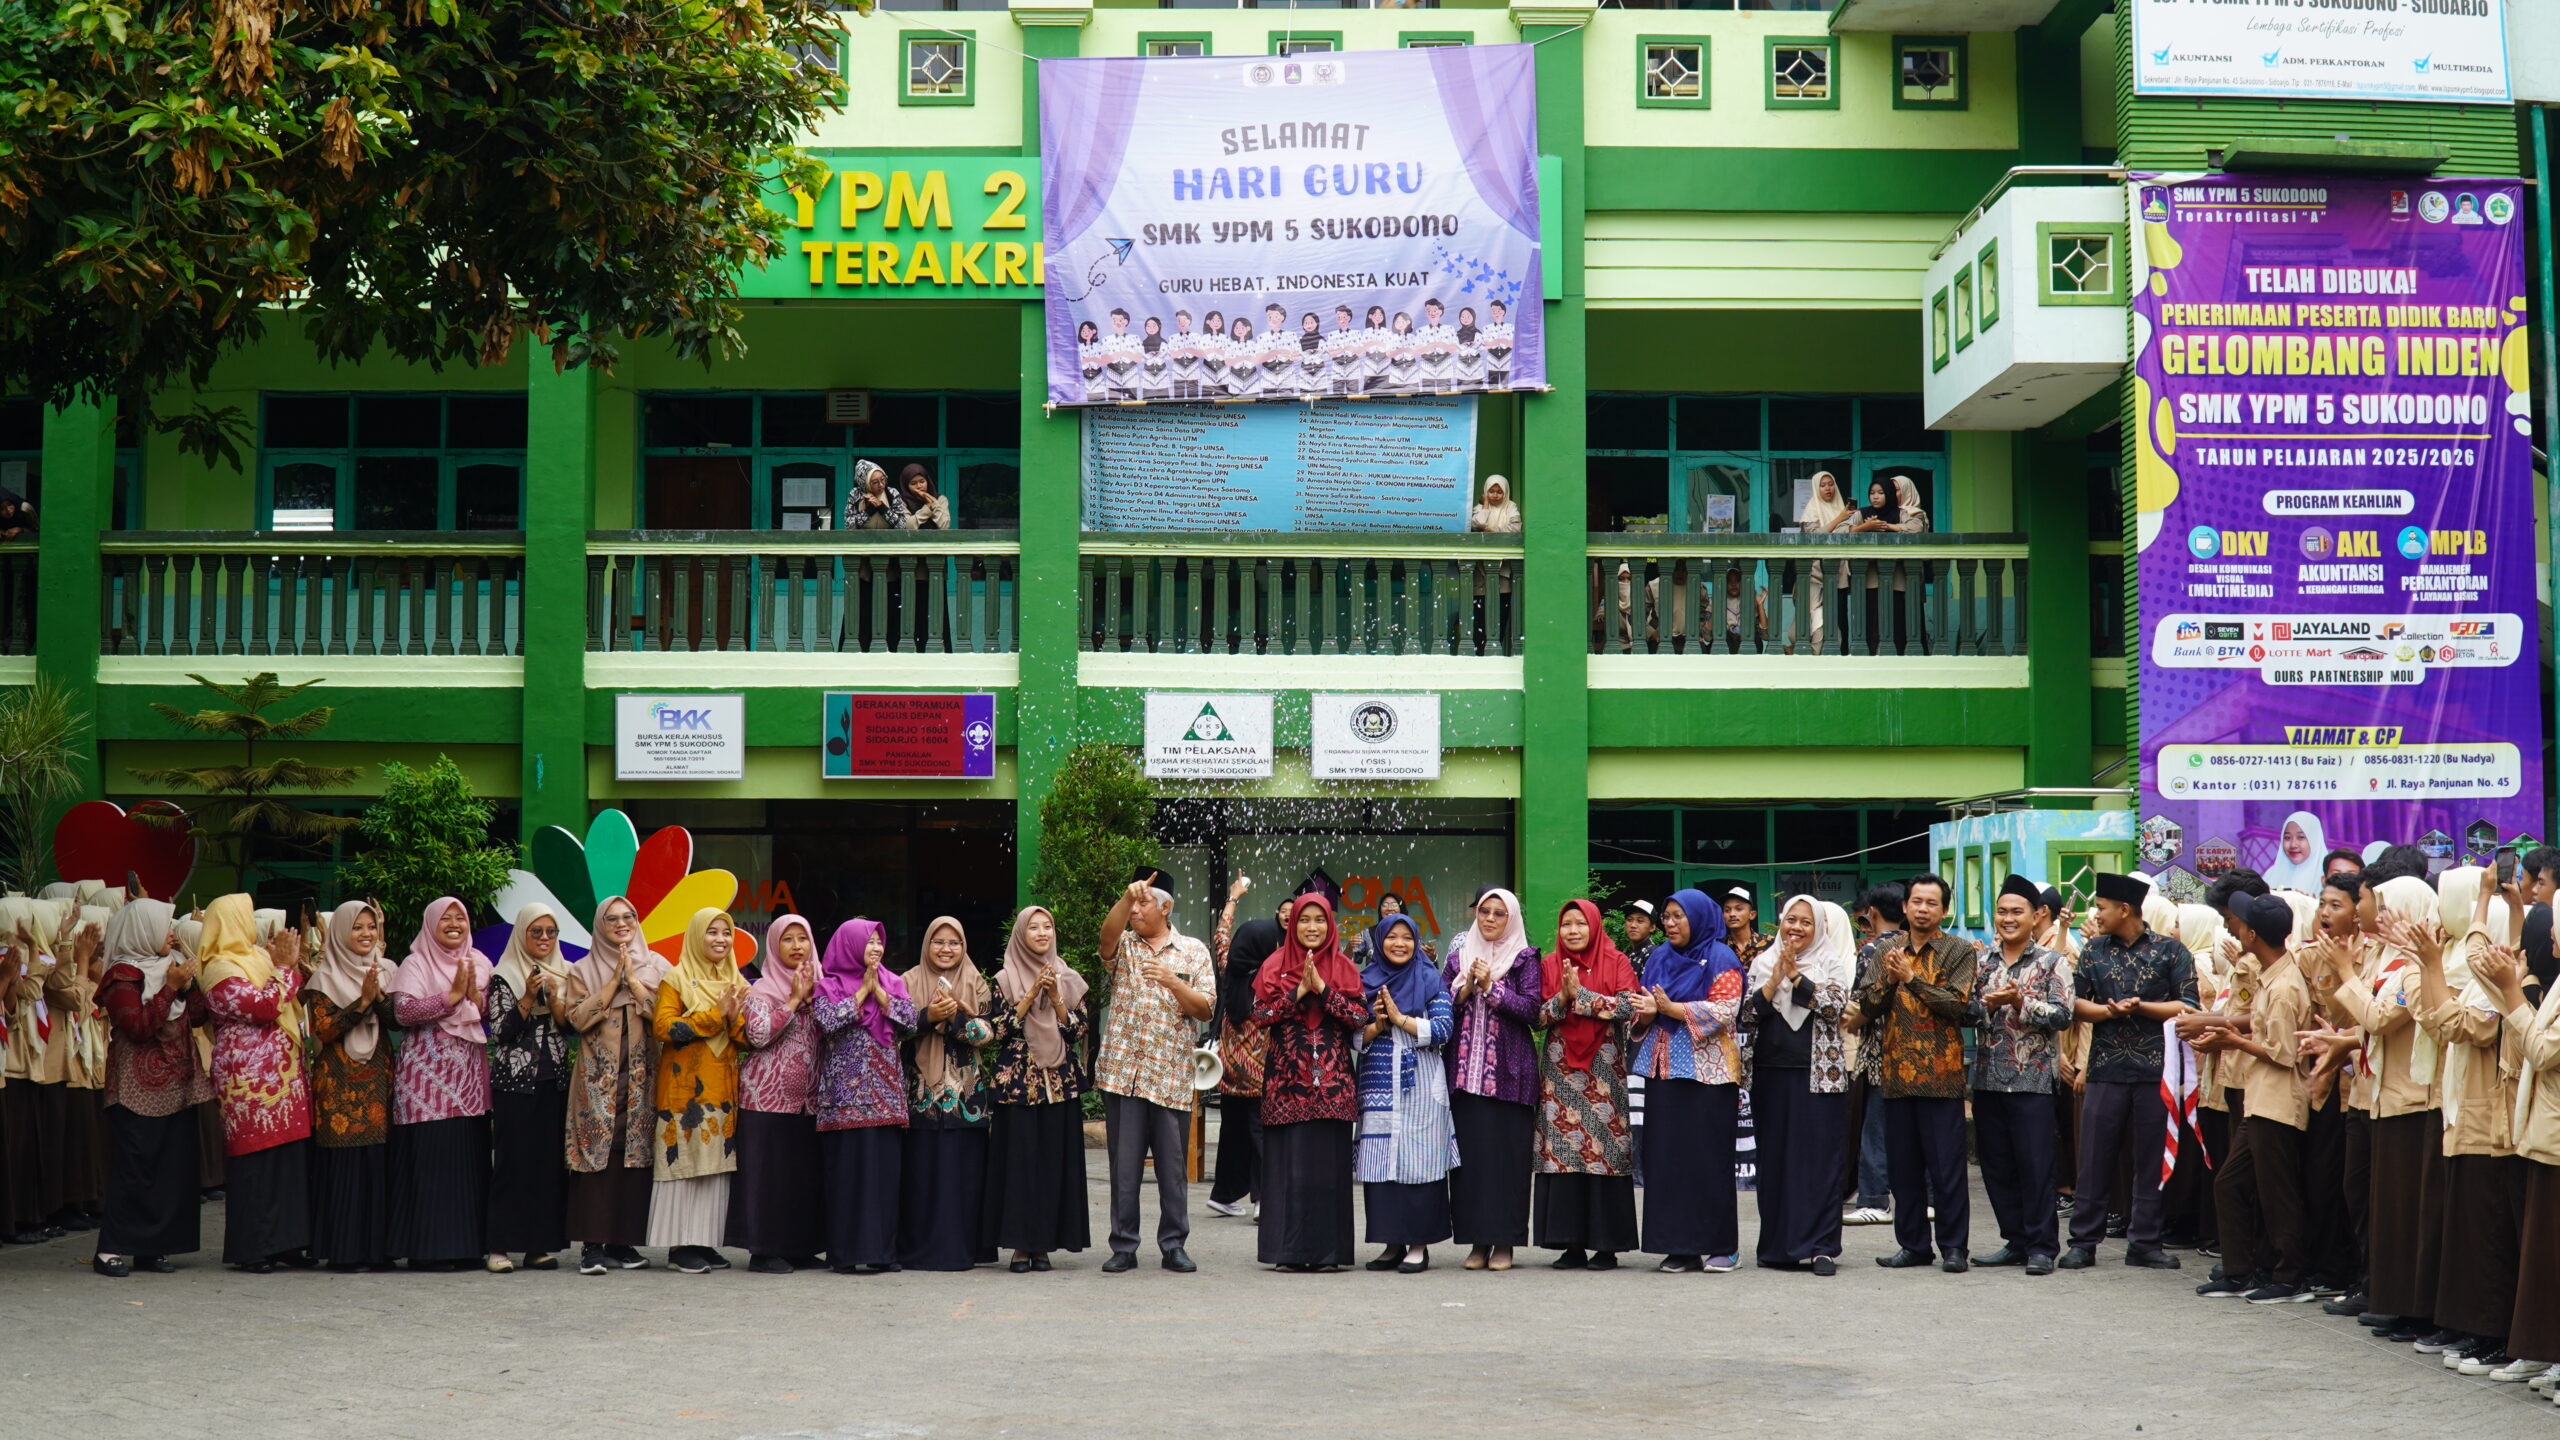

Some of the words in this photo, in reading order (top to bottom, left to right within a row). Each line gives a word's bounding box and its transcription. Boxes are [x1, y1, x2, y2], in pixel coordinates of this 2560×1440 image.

[2412, 0, 2489, 17] SIDOARJO
[2247, 16, 2292, 37] Lembaga
[2298, 17, 2358, 39] Sertifikasi
[2363, 20, 2406, 42] Profesi
[2172, 54, 2233, 63] AKUNTANSI
[2282, 57, 2308, 65] ADM.
[2310, 58, 2385, 68] PERKANTORAN
[2433, 63, 2493, 73] MULTIMEDIA
[1221, 122, 1370, 156] SELAMAT
[1173, 165, 1281, 201] HARI
[1304, 161, 1423, 197] GURU
[782, 170, 953, 230] YPM
[983, 170, 1027, 230] 2
[2174, 187, 2206, 202] SMK
[2208, 188, 2238, 202] YPM
[2240, 188, 2250, 202] 5
[2253, 187, 2328, 203] SUKODONO
[2176, 210, 2297, 223] Terakreditasi
[1142, 222, 1202, 246] SMK
[1285, 218, 1299, 242] 5
[1310, 214, 1459, 241] SUKODONO
[1159, 278, 1203, 294] GURU
[1277, 273, 1378, 290] INDONESIA
[1385, 271, 1430, 287] KUAT
[2245, 268, 2316, 293] TELAH
[2322, 269, 2417, 294] DIBUKA!
[2161, 304, 2291, 326] PENERIMAAN
[2297, 305, 2382, 327] PESERTA
[2386, 305, 2442, 328] DIDIK
[2447, 306, 2497, 329] BARU
[2161, 334, 2386, 376] GELOMBANG
[2398, 336, 2500, 377] INDEN
[2179, 393, 2242, 424] SMK
[2249, 394, 2308, 424] YPM
[2316, 394, 2335, 425] 5
[2342, 394, 2487, 425] SUKODONO
[2196, 448, 2257, 466] TAHUN
[2263, 449, 2366, 466] PELAJARAN
[2372, 448, 2475, 466] 2025/2026
[2276, 495, 2339, 509] PROGRAM
[2343, 495, 2402, 508] KEAHLIAN
[2221, 531, 2269, 556] DKV
[2336, 530, 2381, 557] AKL
[2430, 529, 2487, 555] MPLB
[2188, 564, 2218, 574] DESAIN
[2219, 564, 2272, 574] KOMUNIKASI
[2298, 564, 2384, 582] AKUNTANSI
[2420, 564, 2471, 575] MANAJEMEN
[2216, 574, 2245, 584] VISUAL
[2401, 575, 2488, 591] PERKANTORAN
[2188, 583, 2274, 598] (MULTIMEDIA)
[2298, 586, 2305, 594] &
[2306, 585, 2348, 594] KEUANGAN
[2349, 584, 2384, 594] LEMBAGA
[2412, 592, 2419, 601] &
[2420, 592, 2452, 601] LAYANAN
[2454, 591, 2479, 601] BISNIS
[2293, 622, 2371, 635] JAYALAND
[2401, 632, 2444, 641] Collection
[2173, 646, 2202, 657] Bank
[2218, 646, 2246, 657] BTN
[2306, 648, 2332, 657] Mart
[2274, 670, 2303, 683] OURS
[2310, 670, 2384, 683] PARTNERSHIP
[2391, 669, 2414, 683] MOU
[855, 701, 906, 709] GERAKAN
[909, 701, 961, 709] PRAMUKA
[659, 709, 713, 730] BKK
[875, 712, 908, 720] GUGUS
[910, 712, 942, 720] DEPAN
[866, 726, 918, 734] SIDOARJO
[2292, 728, 2356, 745] ALAMAT
[2358, 731, 2370, 745] &
[2375, 728, 2397, 745] CP
[866, 736, 918, 744] SIDOARJO
[1162, 747, 1181, 755] TIM
[1185, 746, 1256, 755] PELAKSANA
[2210, 756, 2292, 766] 0856-0727-1413
[2301, 756, 2314, 766] Bu
[2317, 756, 2336, 766] Faiz
[2364, 754, 2440, 765] 0856-0831-1220
[2443, 754, 2458, 765] (Bu
[2461, 753, 2495, 766] Nadya)
[2192, 780, 2237, 790] Kantor
[2287, 780, 2337, 790] 7876116
[2386, 779, 2397, 789] Jl.
[2401, 779, 2425, 790] Raya
[2429, 778, 2473, 790] Panjunan
[2477, 778, 2494, 788] No.
[2497, 777, 2510, 787] 45
[727, 879, 799, 915] MA
